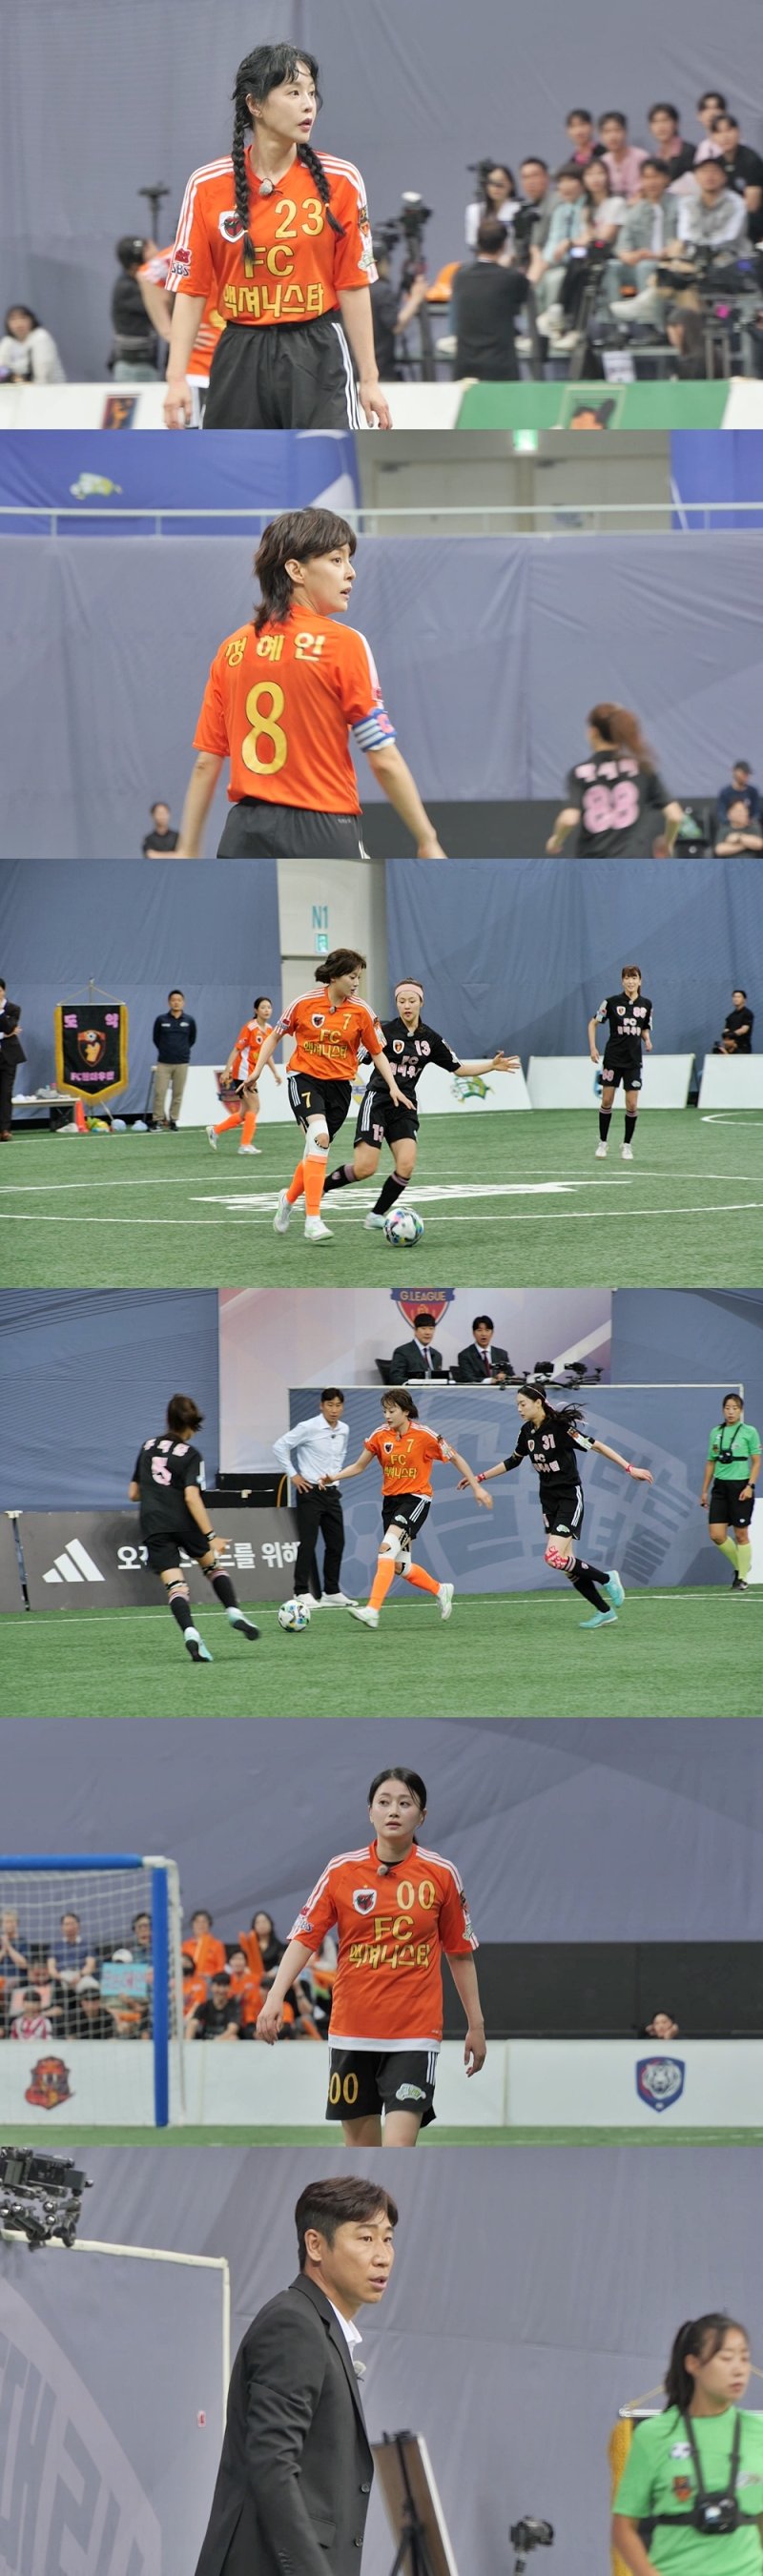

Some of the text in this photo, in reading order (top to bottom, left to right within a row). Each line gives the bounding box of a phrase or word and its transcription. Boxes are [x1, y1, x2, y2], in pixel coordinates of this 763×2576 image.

[275, 197, 324, 238] 23
[171, 262, 190, 276] SBS
[243, 245, 295, 278] FC
[241, 681, 288, 775] 8
[583, 781, 640, 834] 88
[312, 905, 328, 930] N1
[342, 1013, 352, 1031] 7
[320, 1029, 341, 1043] FC
[414, 1040, 431, 1056] 13
[402, 1055, 419, 1066] FC
[301, 1091, 311, 1109] 7
[406, 1439, 414, 1453] 7
[542, 1434, 556, 1450] 31
[390, 1454, 406, 1465] FC
[151, 1456, 172, 1485] 5
[397, 1880, 436, 1911] 00
[374, 1915, 414, 1941] FC
[329, 2072, 359, 2105] 00
